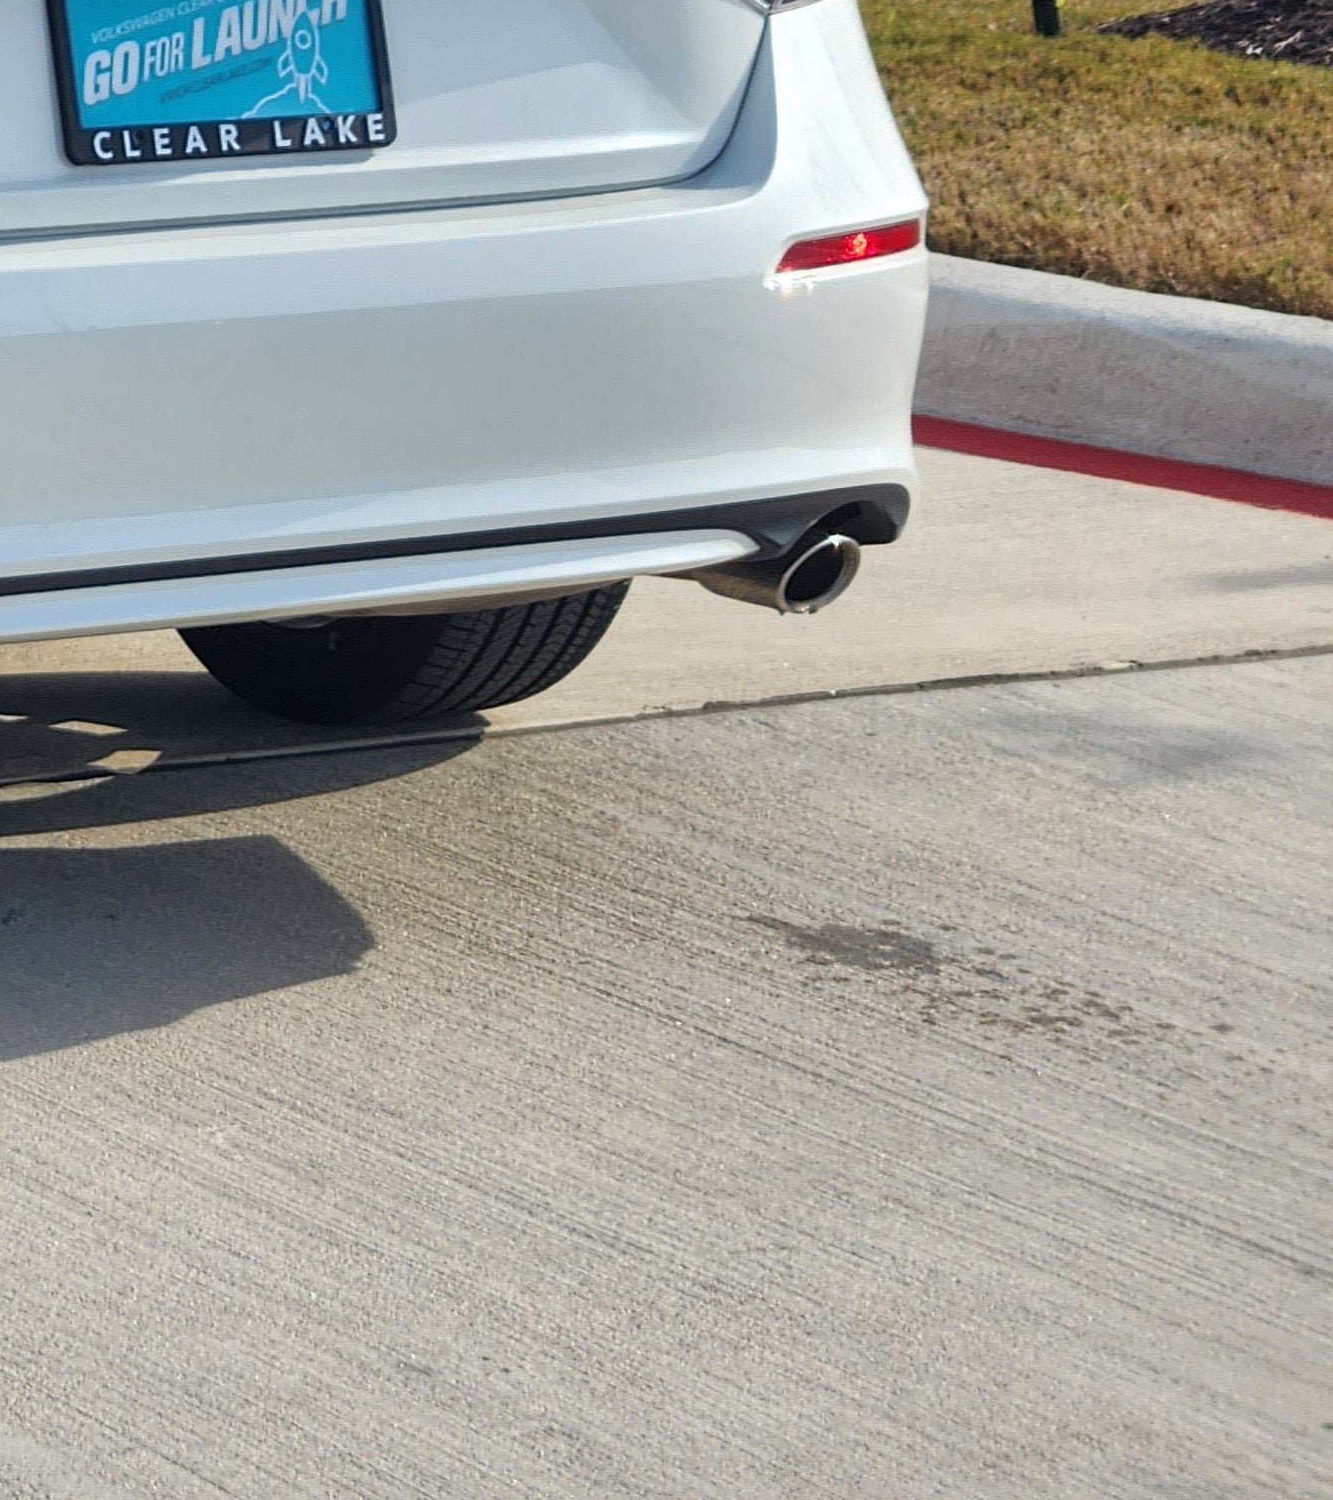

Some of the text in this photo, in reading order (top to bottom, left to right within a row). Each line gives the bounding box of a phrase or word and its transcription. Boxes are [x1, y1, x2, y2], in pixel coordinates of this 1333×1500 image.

[83, 40, 141, 105] GO
[143, 31, 185, 81] FOR
[93, 112, 386, 160] CLEAR LAKE
